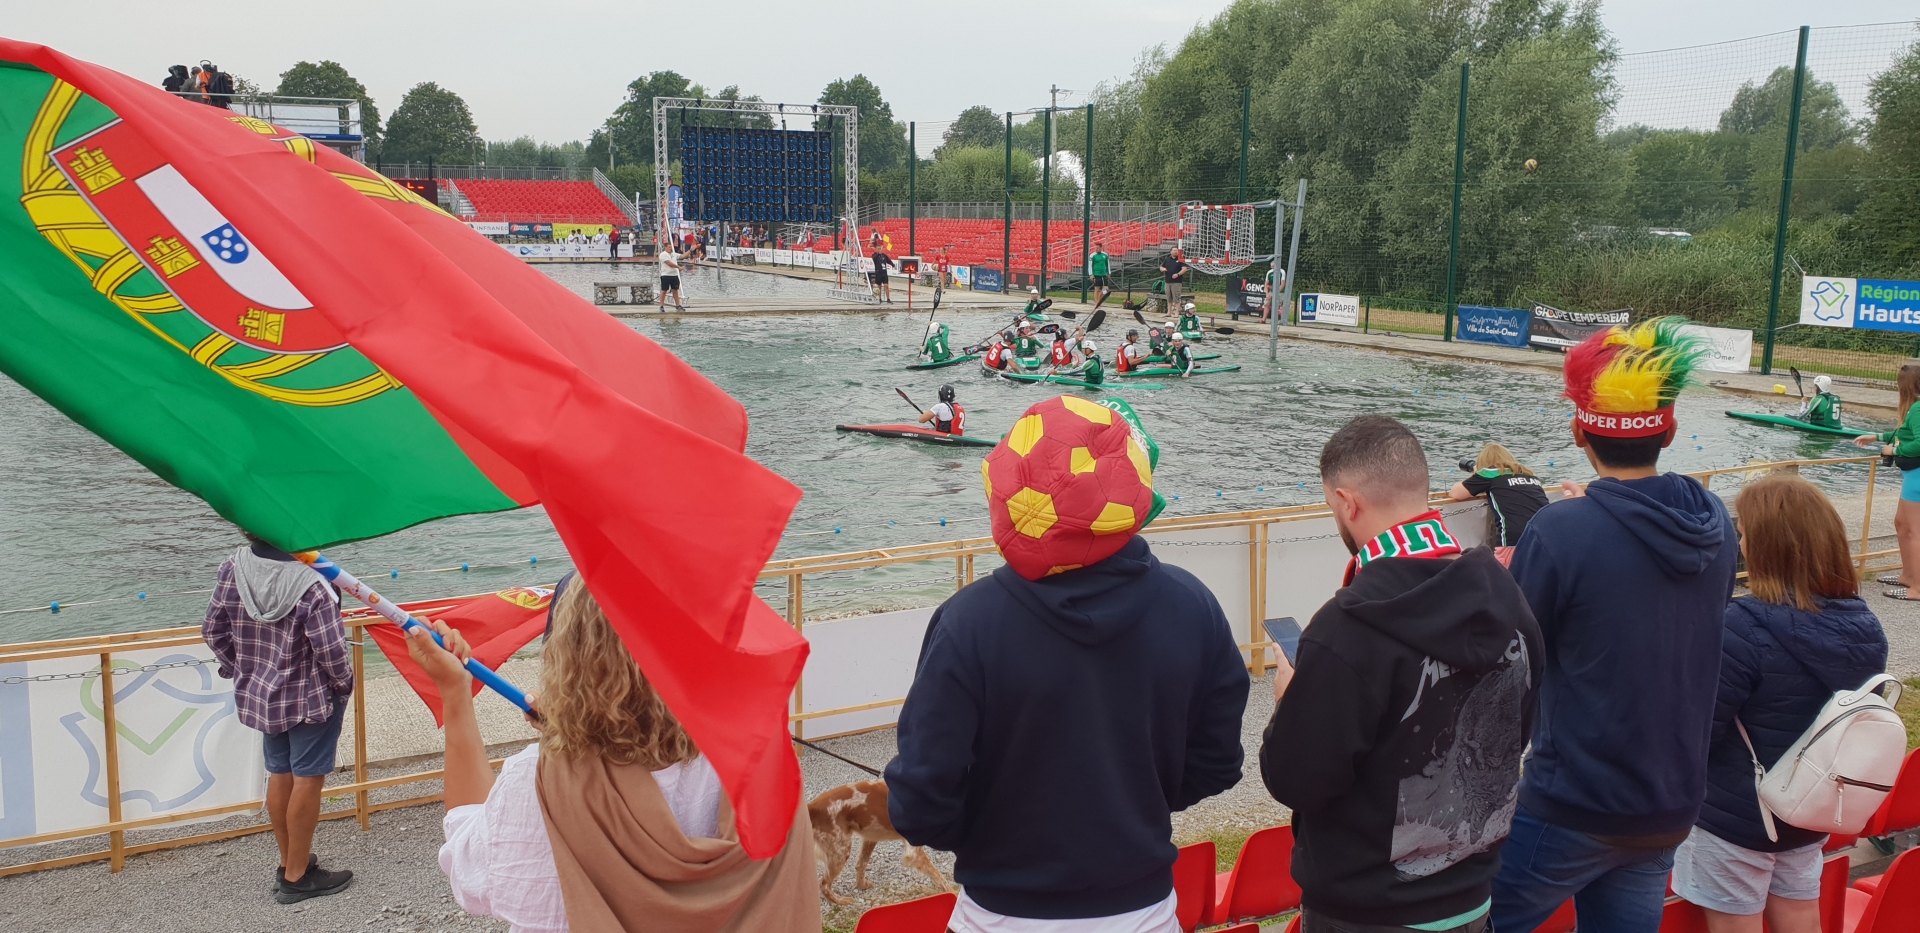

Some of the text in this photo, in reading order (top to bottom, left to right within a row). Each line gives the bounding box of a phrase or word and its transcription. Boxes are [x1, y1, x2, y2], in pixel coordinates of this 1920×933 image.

[1861, 284, 1920, 303] Région
[1535, 305, 1629, 324] GROUPE LEMPEREUR
[1466, 324, 1477, 332] Ville
[1485, 325, 1519, 337] Saint-Omer
[935, 341, 943, 354] 1
[1021, 338, 1029, 349] 9
[989, 347, 998, 361] 5
[1055, 347, 1064, 360] 3
[1117, 351, 1123, 365] 1
[1577, 407, 1664, 430] SUPER BOCK
[1832, 403, 1841, 420] 5
[958, 412, 965, 430] 2
